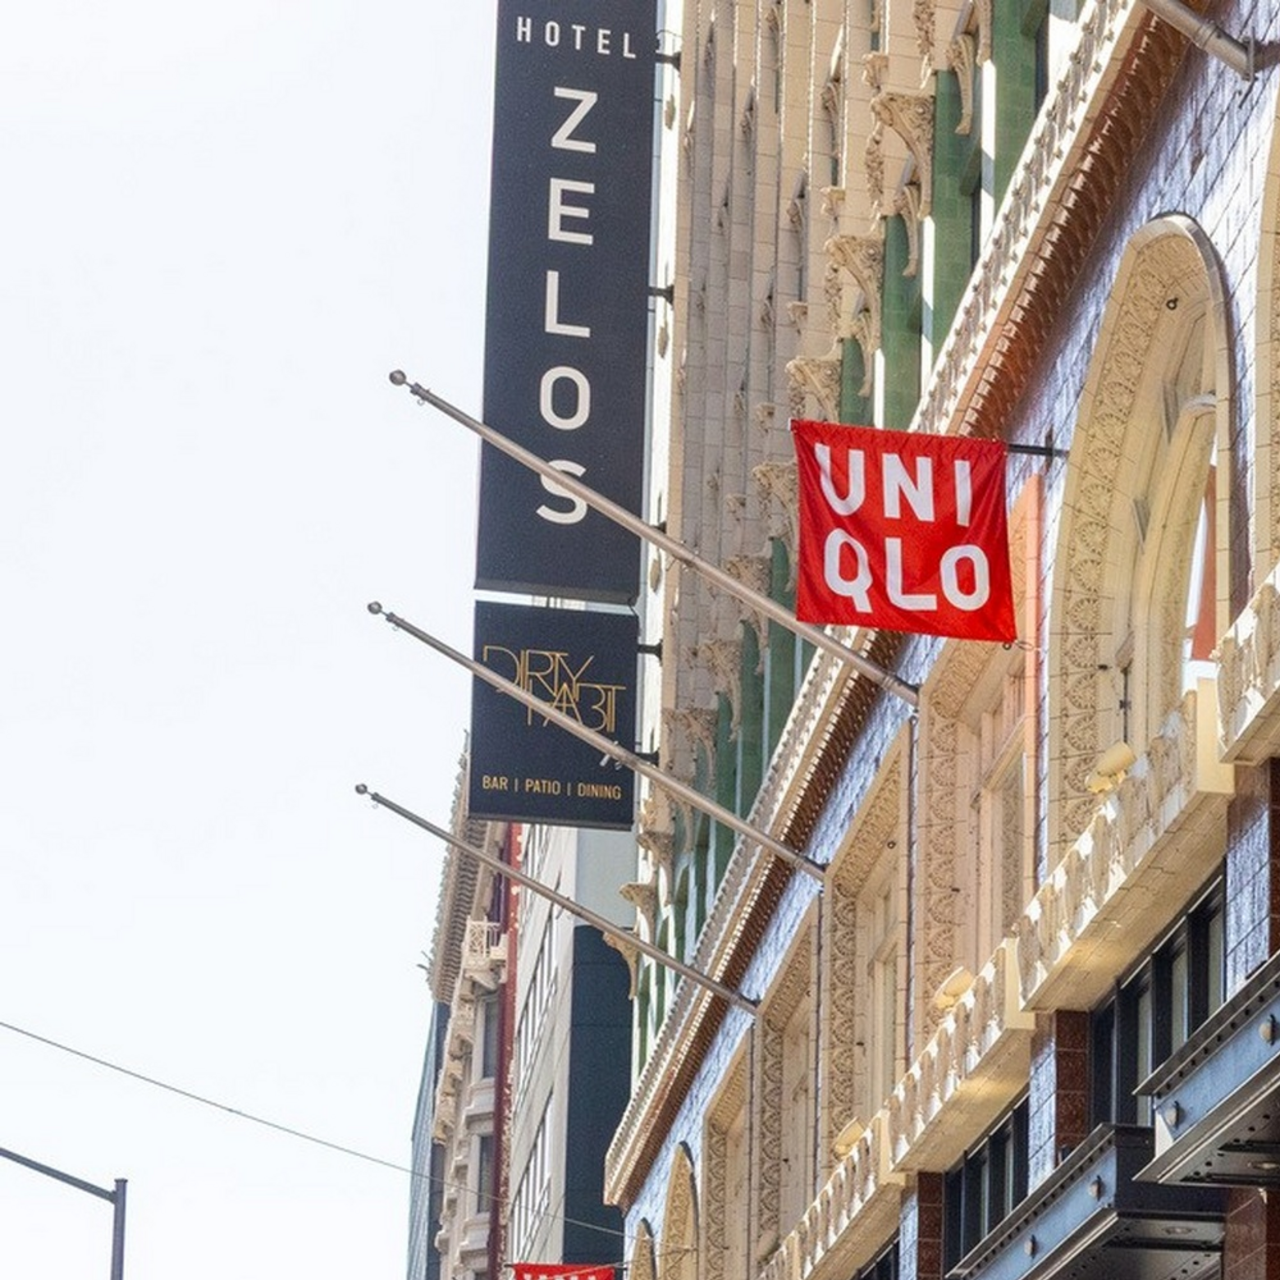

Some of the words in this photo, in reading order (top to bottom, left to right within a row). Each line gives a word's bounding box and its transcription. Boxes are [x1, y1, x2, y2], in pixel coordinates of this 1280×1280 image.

[516, 15, 637, 59] HOTEL
[535, 85, 599, 525] ZELOS
[813, 442, 973, 527] UNI
[823, 527, 991, 613] QLO
[483, 645, 595, 703] DIRTY
[482, 775, 508, 790] BAR
[525, 778, 562, 795] PATIO
[577, 784, 622, 800] DINING
